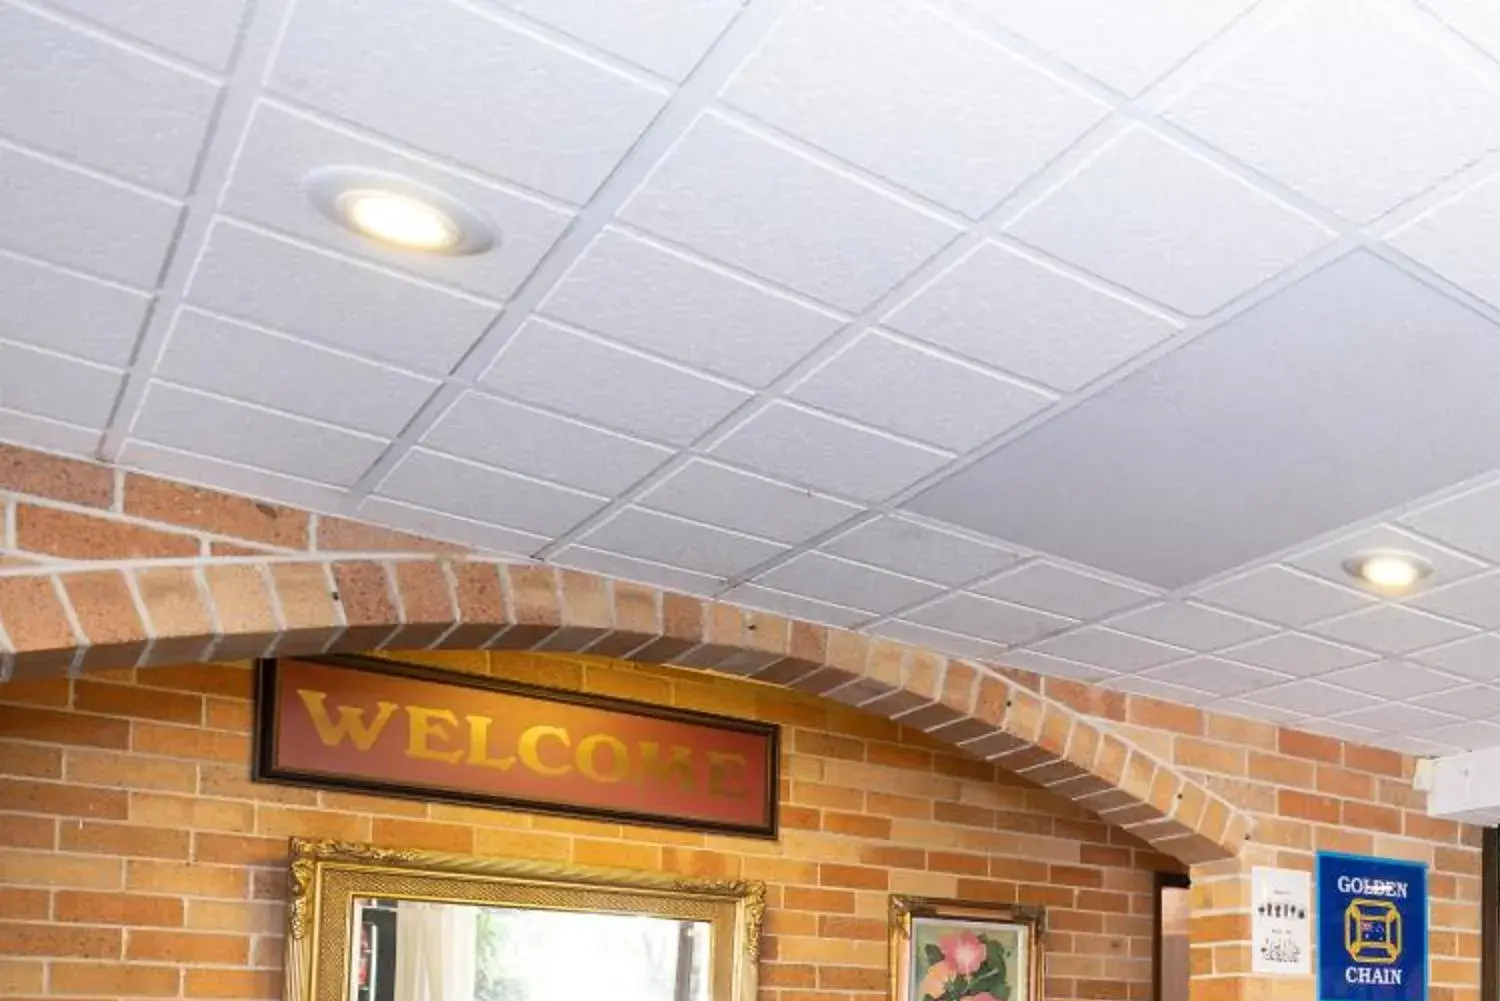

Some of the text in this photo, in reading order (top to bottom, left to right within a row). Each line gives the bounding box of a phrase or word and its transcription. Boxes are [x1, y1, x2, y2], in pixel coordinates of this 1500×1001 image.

[297, 688, 748, 798] WELCOME
[1337, 875, 1409, 899] GOLDEN
[1345, 966, 1403, 985] CHAIN
